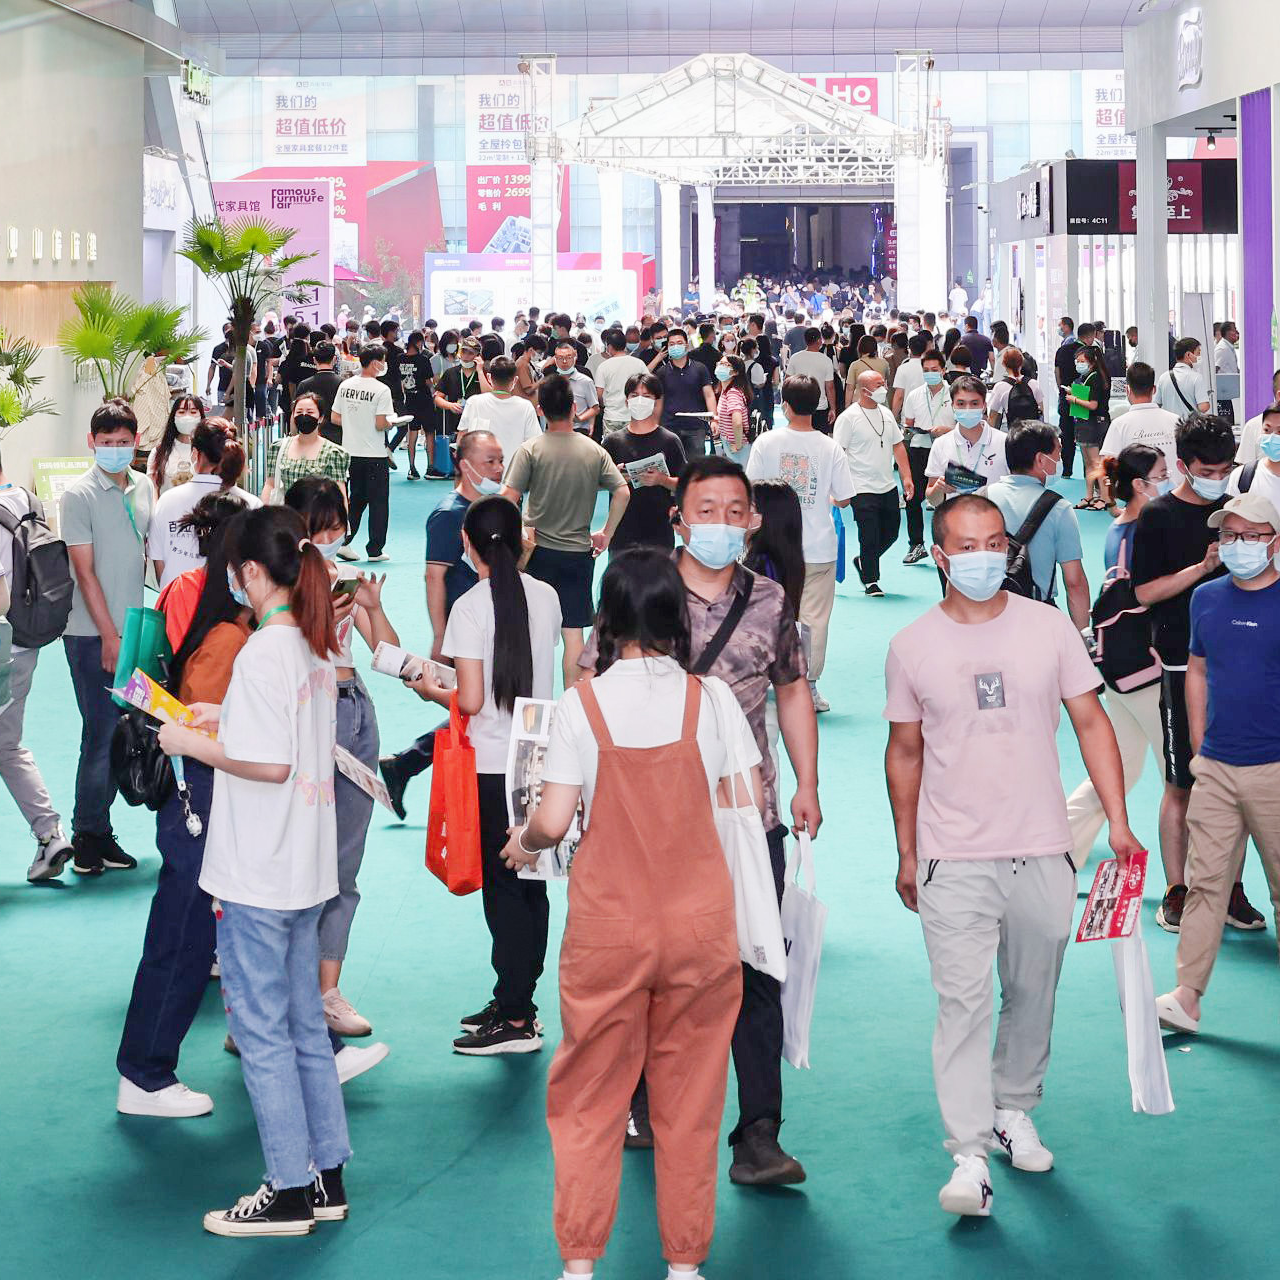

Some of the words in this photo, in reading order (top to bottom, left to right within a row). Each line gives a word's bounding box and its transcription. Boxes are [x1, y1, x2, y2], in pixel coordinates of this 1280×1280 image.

[275, 95, 317, 109] 我们的
[478, 93, 520, 107] 我们的
[275, 118, 347, 136] 超值低价
[478, 139, 530, 150] 全屋拎包
[478, 176, 501, 185] 出厂价
[478, 188, 501, 198] 零售价
